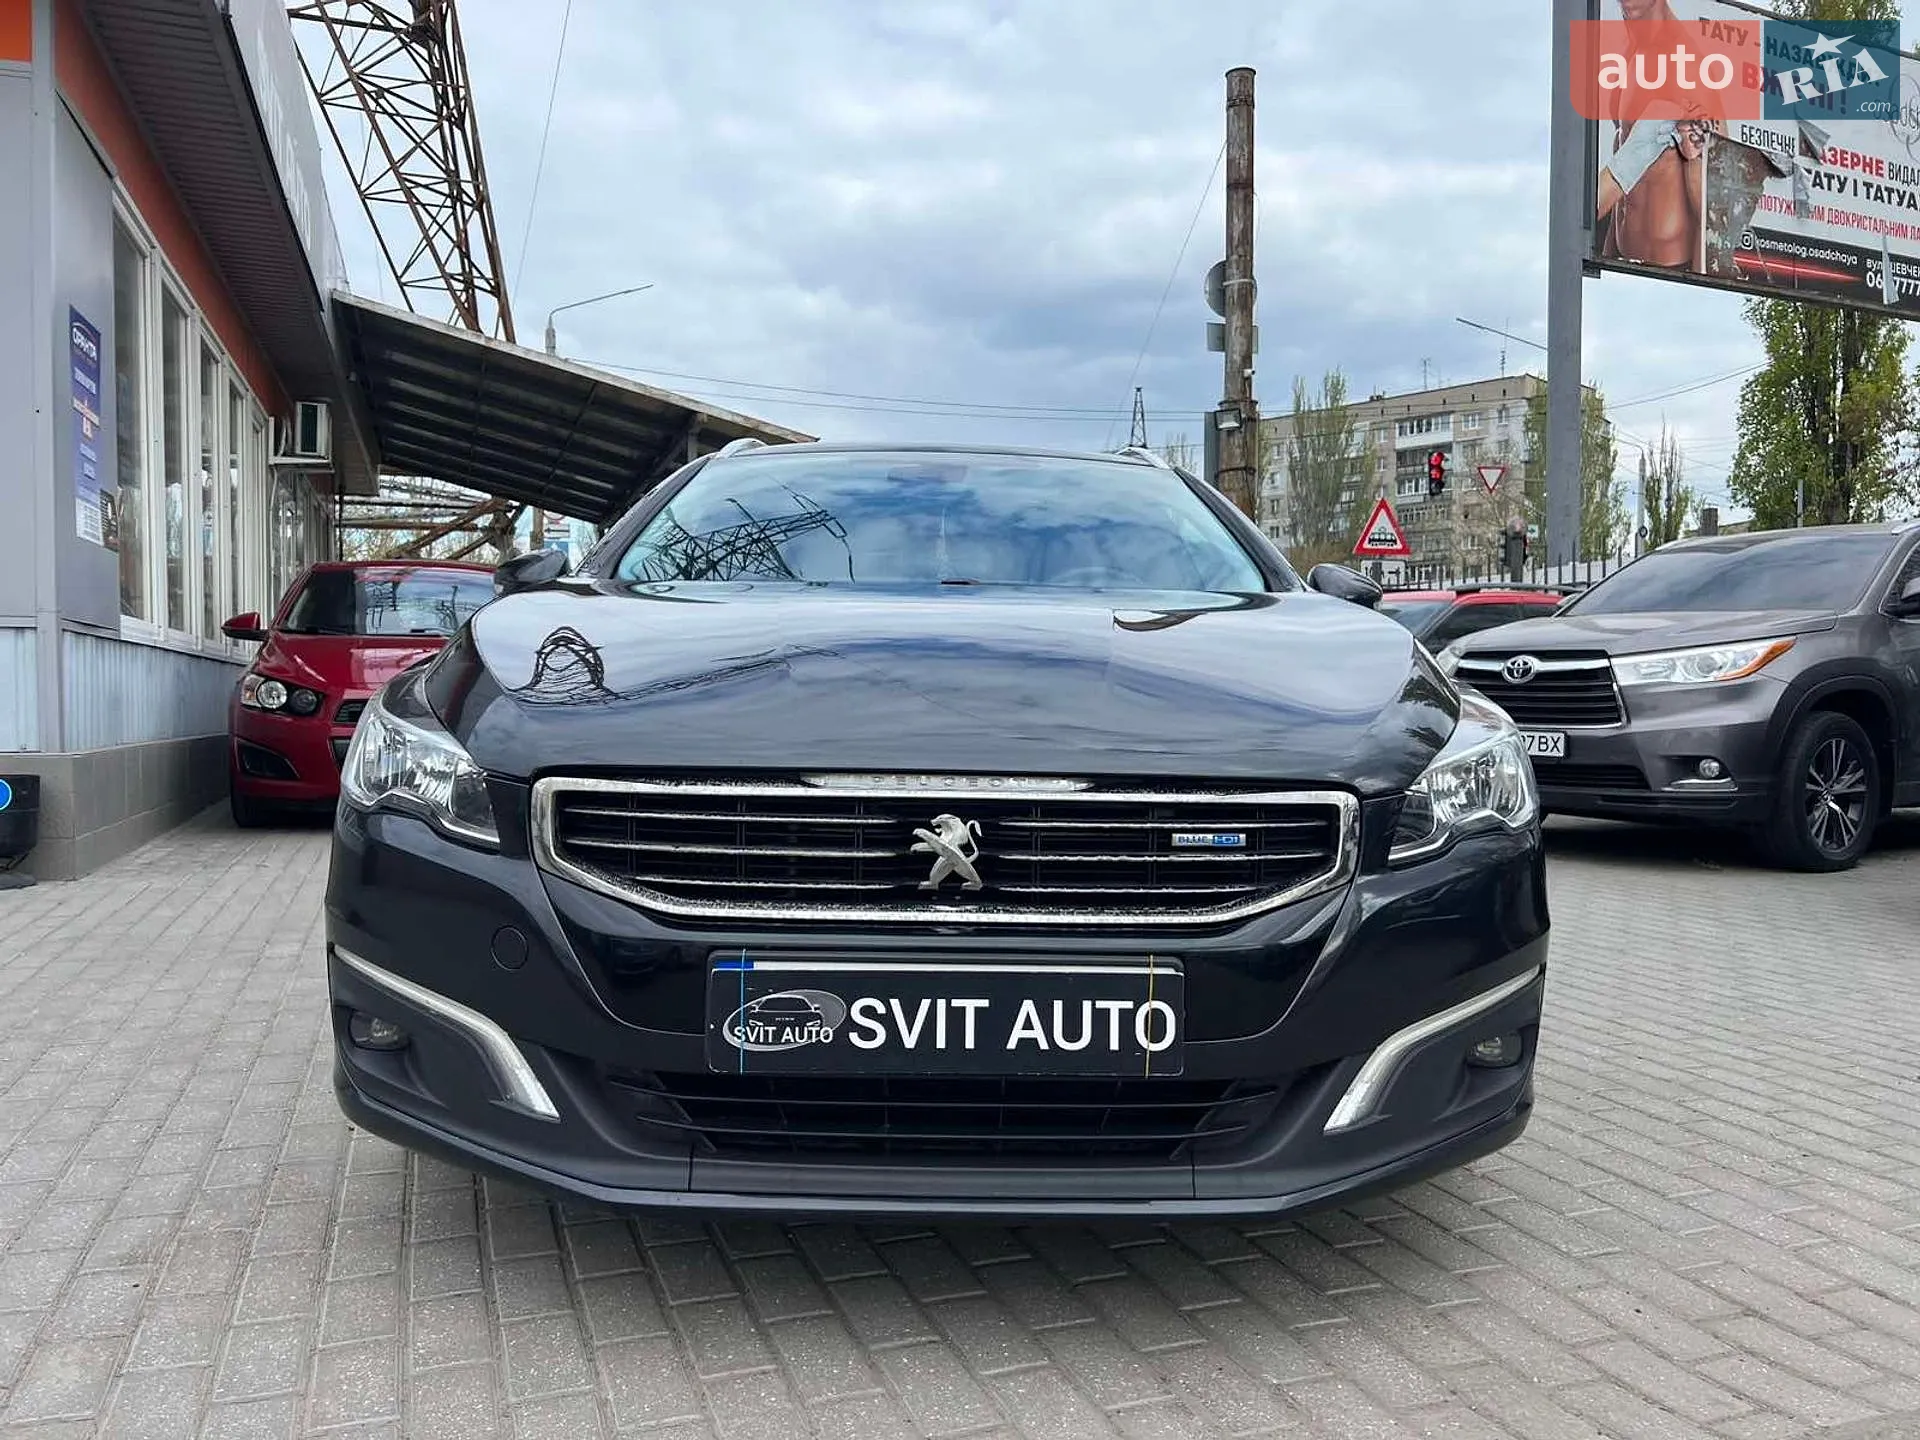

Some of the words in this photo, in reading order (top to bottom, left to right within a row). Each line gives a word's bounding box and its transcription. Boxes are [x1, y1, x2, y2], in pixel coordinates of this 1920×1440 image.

[1827, 207, 1908, 239] ДВОКРИСТАЛЬНИМ
[733, 1026, 777, 1043] SVIT
[781, 1026, 833, 1044] AUTO
[848, 998, 989, 1050] SVIT
[1006, 999, 1176, 1052] AUTO
